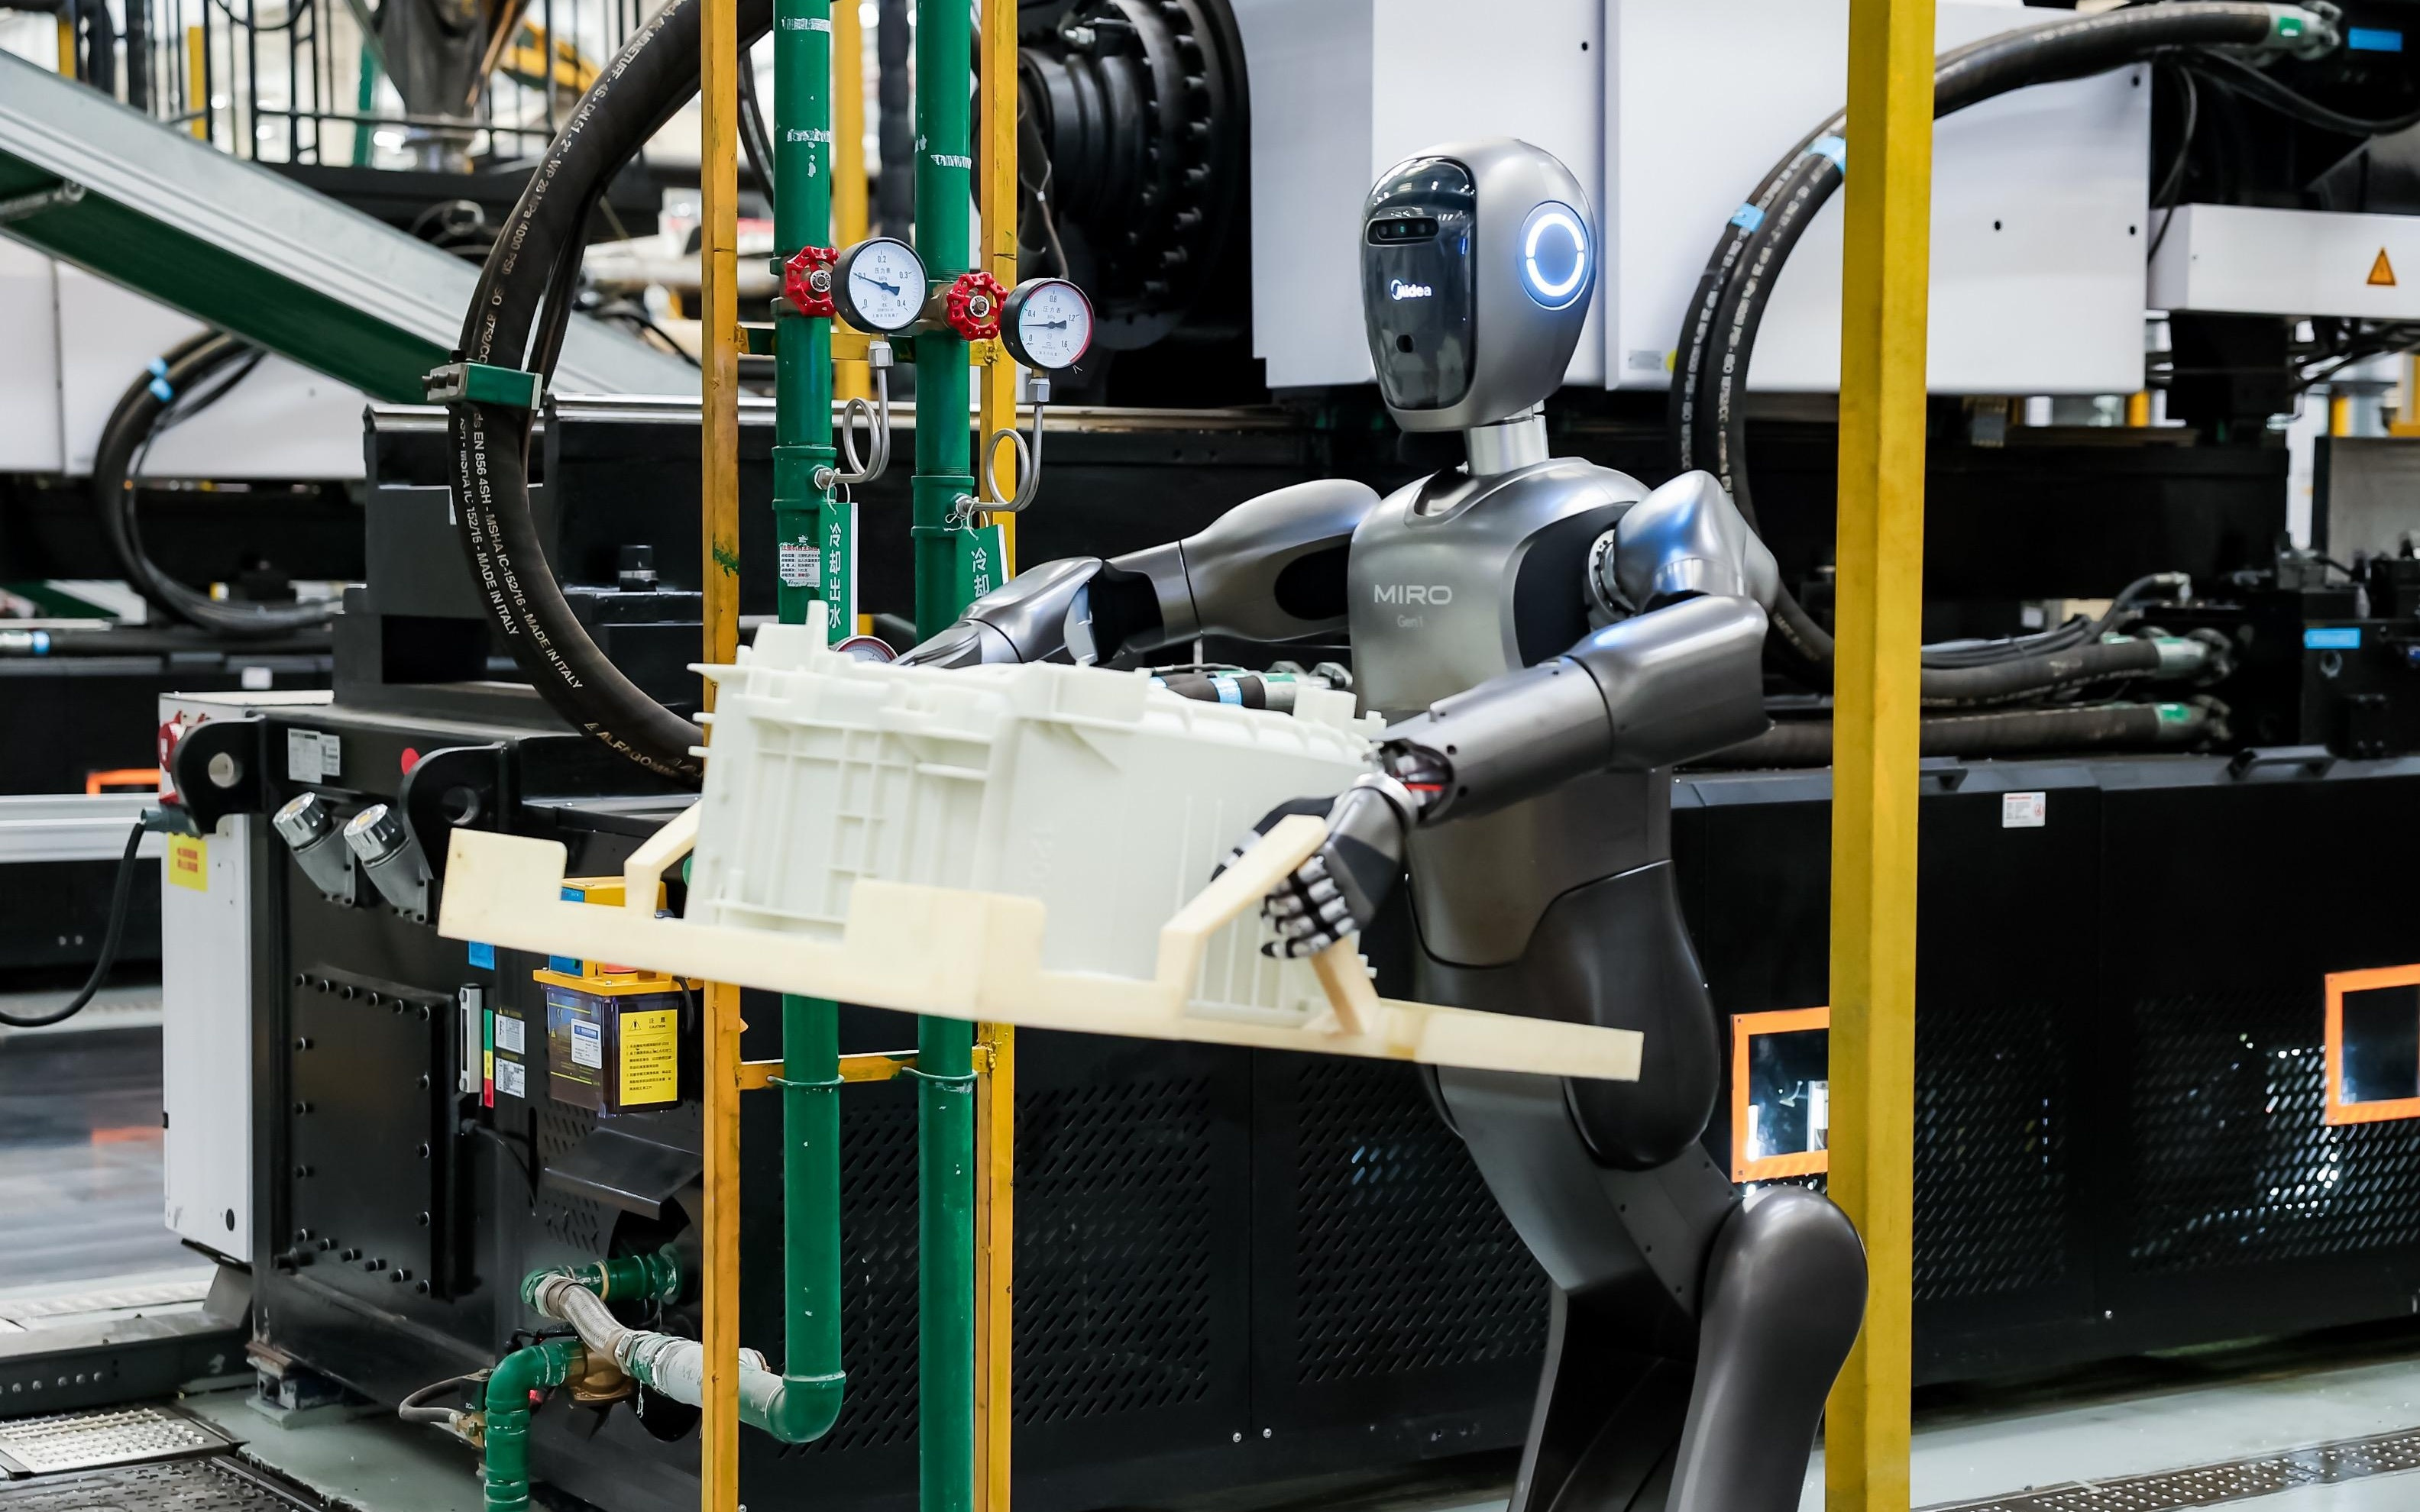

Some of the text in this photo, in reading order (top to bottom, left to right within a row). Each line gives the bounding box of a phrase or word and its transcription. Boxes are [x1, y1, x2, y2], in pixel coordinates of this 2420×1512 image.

[1390, 279, 1432, 301] Midea
[474, 431, 484, 450] EN
[474, 453, 487, 475] 856
[479, 478, 492, 503] 4SH
[485, 513, 503, 553] MSHA
[477, 552, 497, 590] MADE
[497, 554, 526, 606] IC-152/16
[829, 522, 842, 628] 冷却出水
[490, 590, 503, 604] IN
[1374, 584, 1452, 605] MIRO
[496, 604, 519, 635] ITALY
[524, 613, 551, 648] MADE
[545, 648, 560, 661] IN
[555, 661, 583, 688] ITALY
